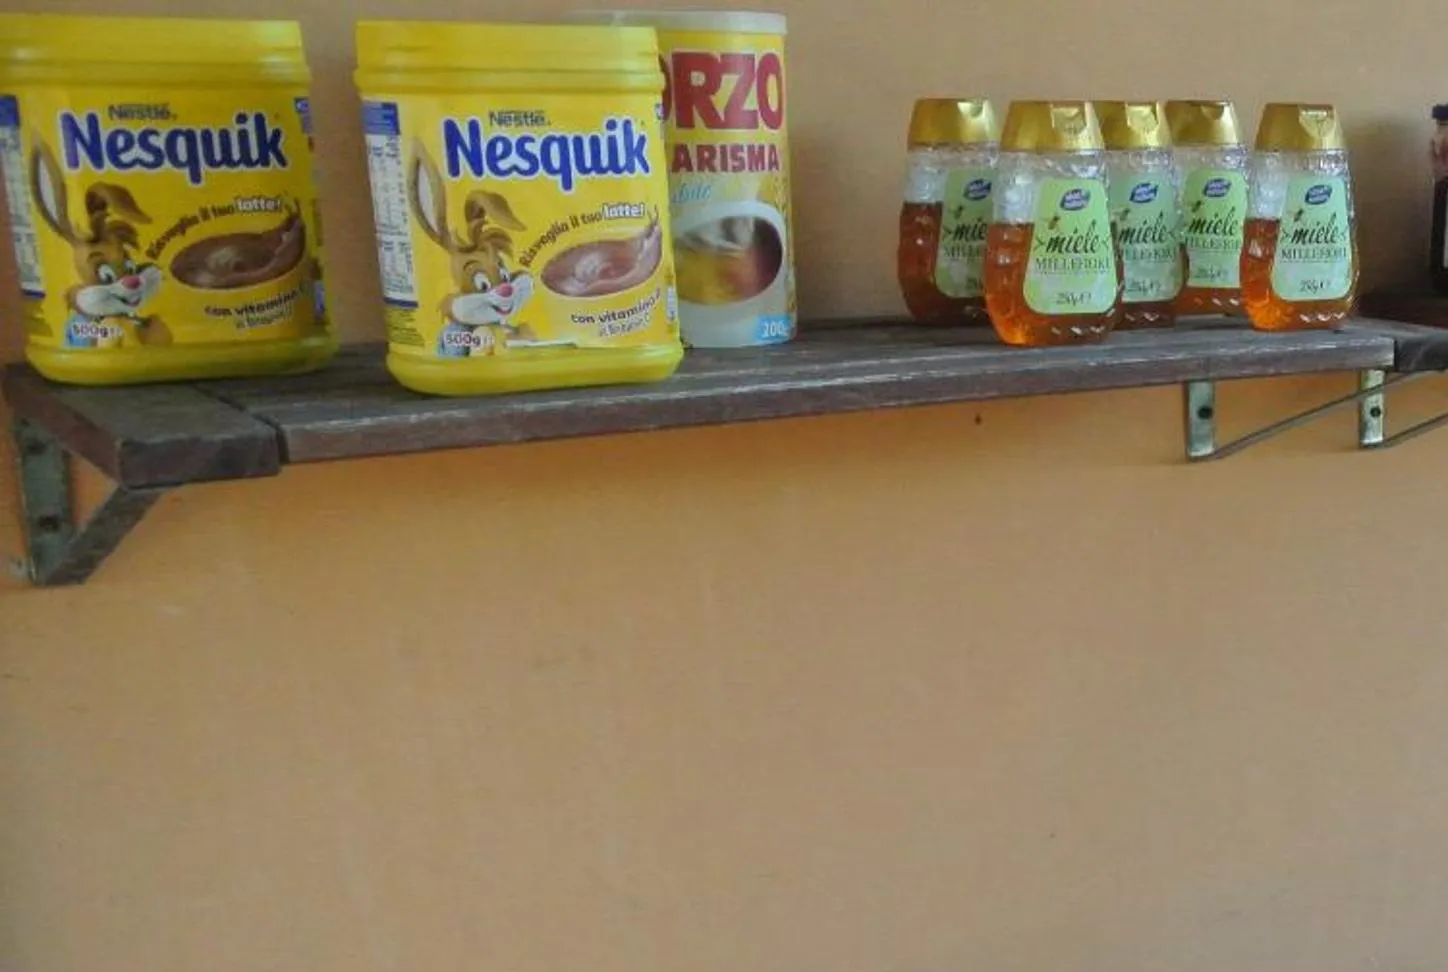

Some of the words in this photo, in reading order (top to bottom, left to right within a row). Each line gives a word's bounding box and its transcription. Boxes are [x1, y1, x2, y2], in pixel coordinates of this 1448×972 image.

[59, 111, 288, 185] Nesquik
[443, 117, 650, 192] Nesquik
[671, 143, 780, 174] ARISMA
[1047, 219, 1101, 255] miele
[1119, 212, 1168, 245] miele
[1189, 206, 1239, 237] miele
[1291, 211, 1338, 244] miele
